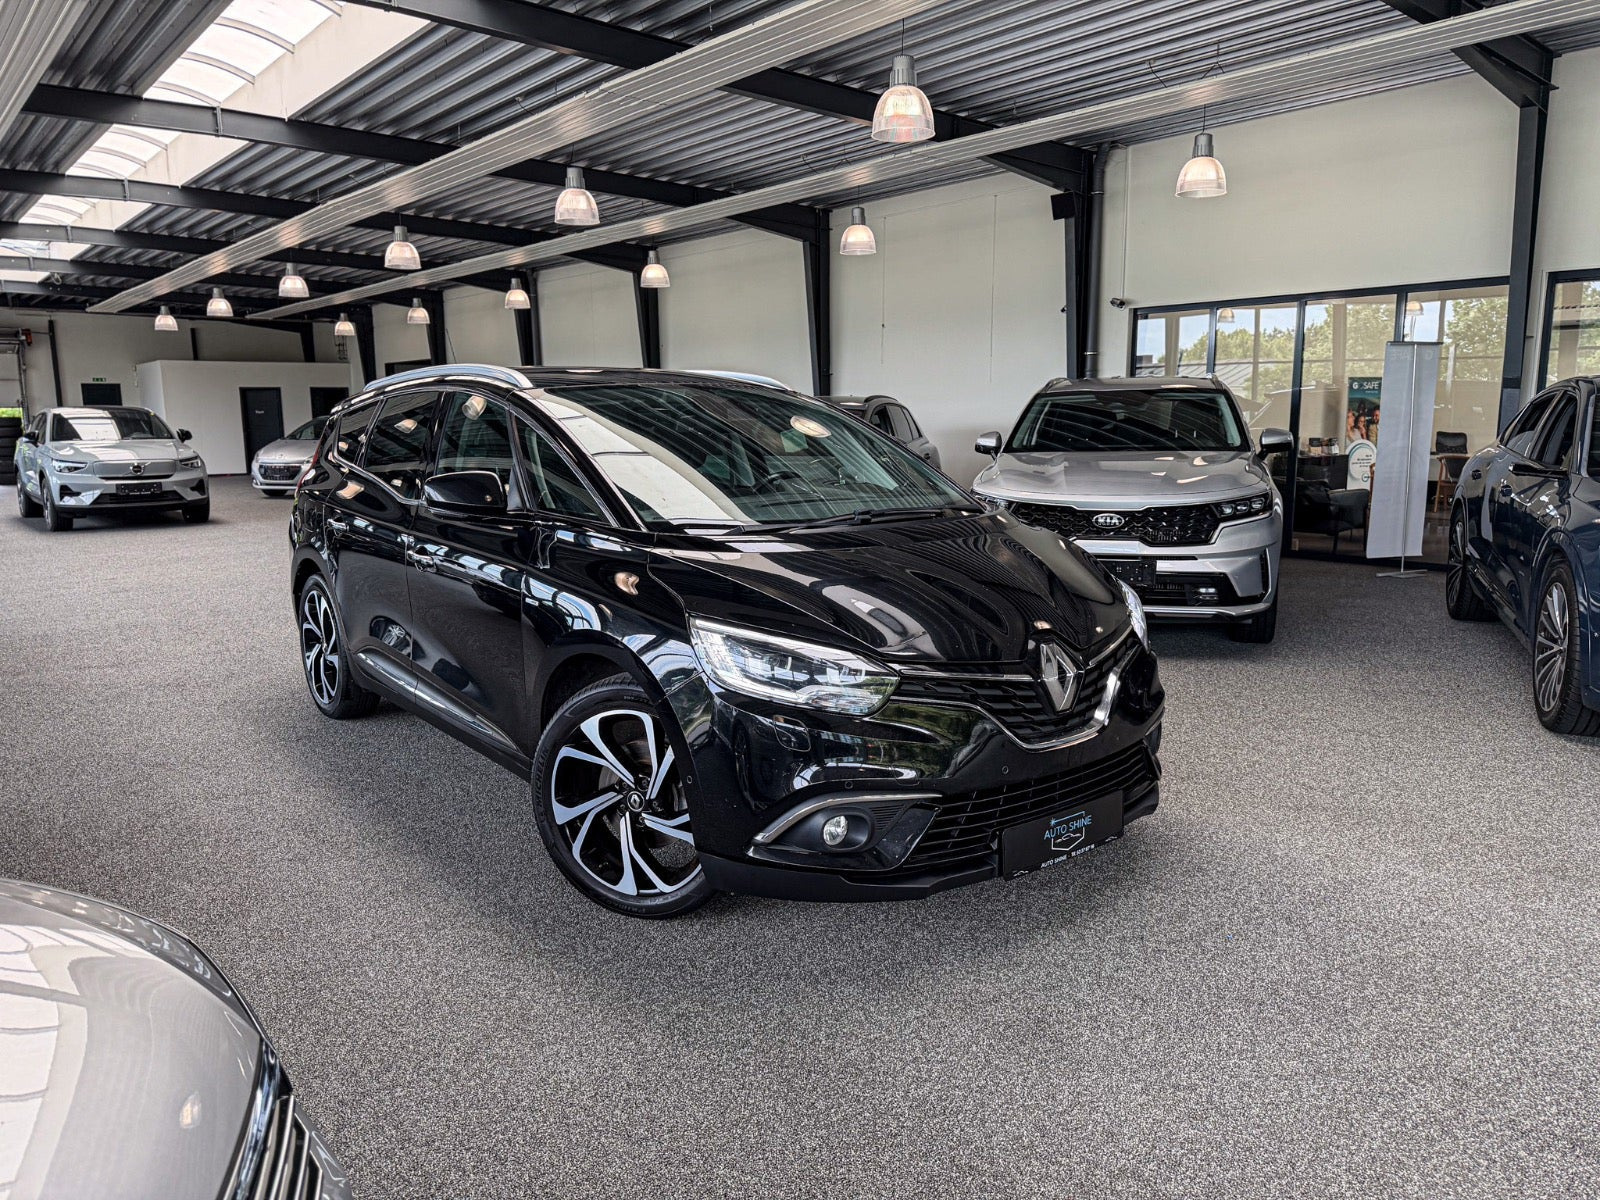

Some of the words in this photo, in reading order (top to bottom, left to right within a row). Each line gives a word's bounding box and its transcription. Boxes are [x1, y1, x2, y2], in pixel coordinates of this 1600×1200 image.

[1098, 516, 1120, 526] KIA
[1044, 824, 1067, 840] AUTO
[1069, 815, 1092, 831] SHINE
